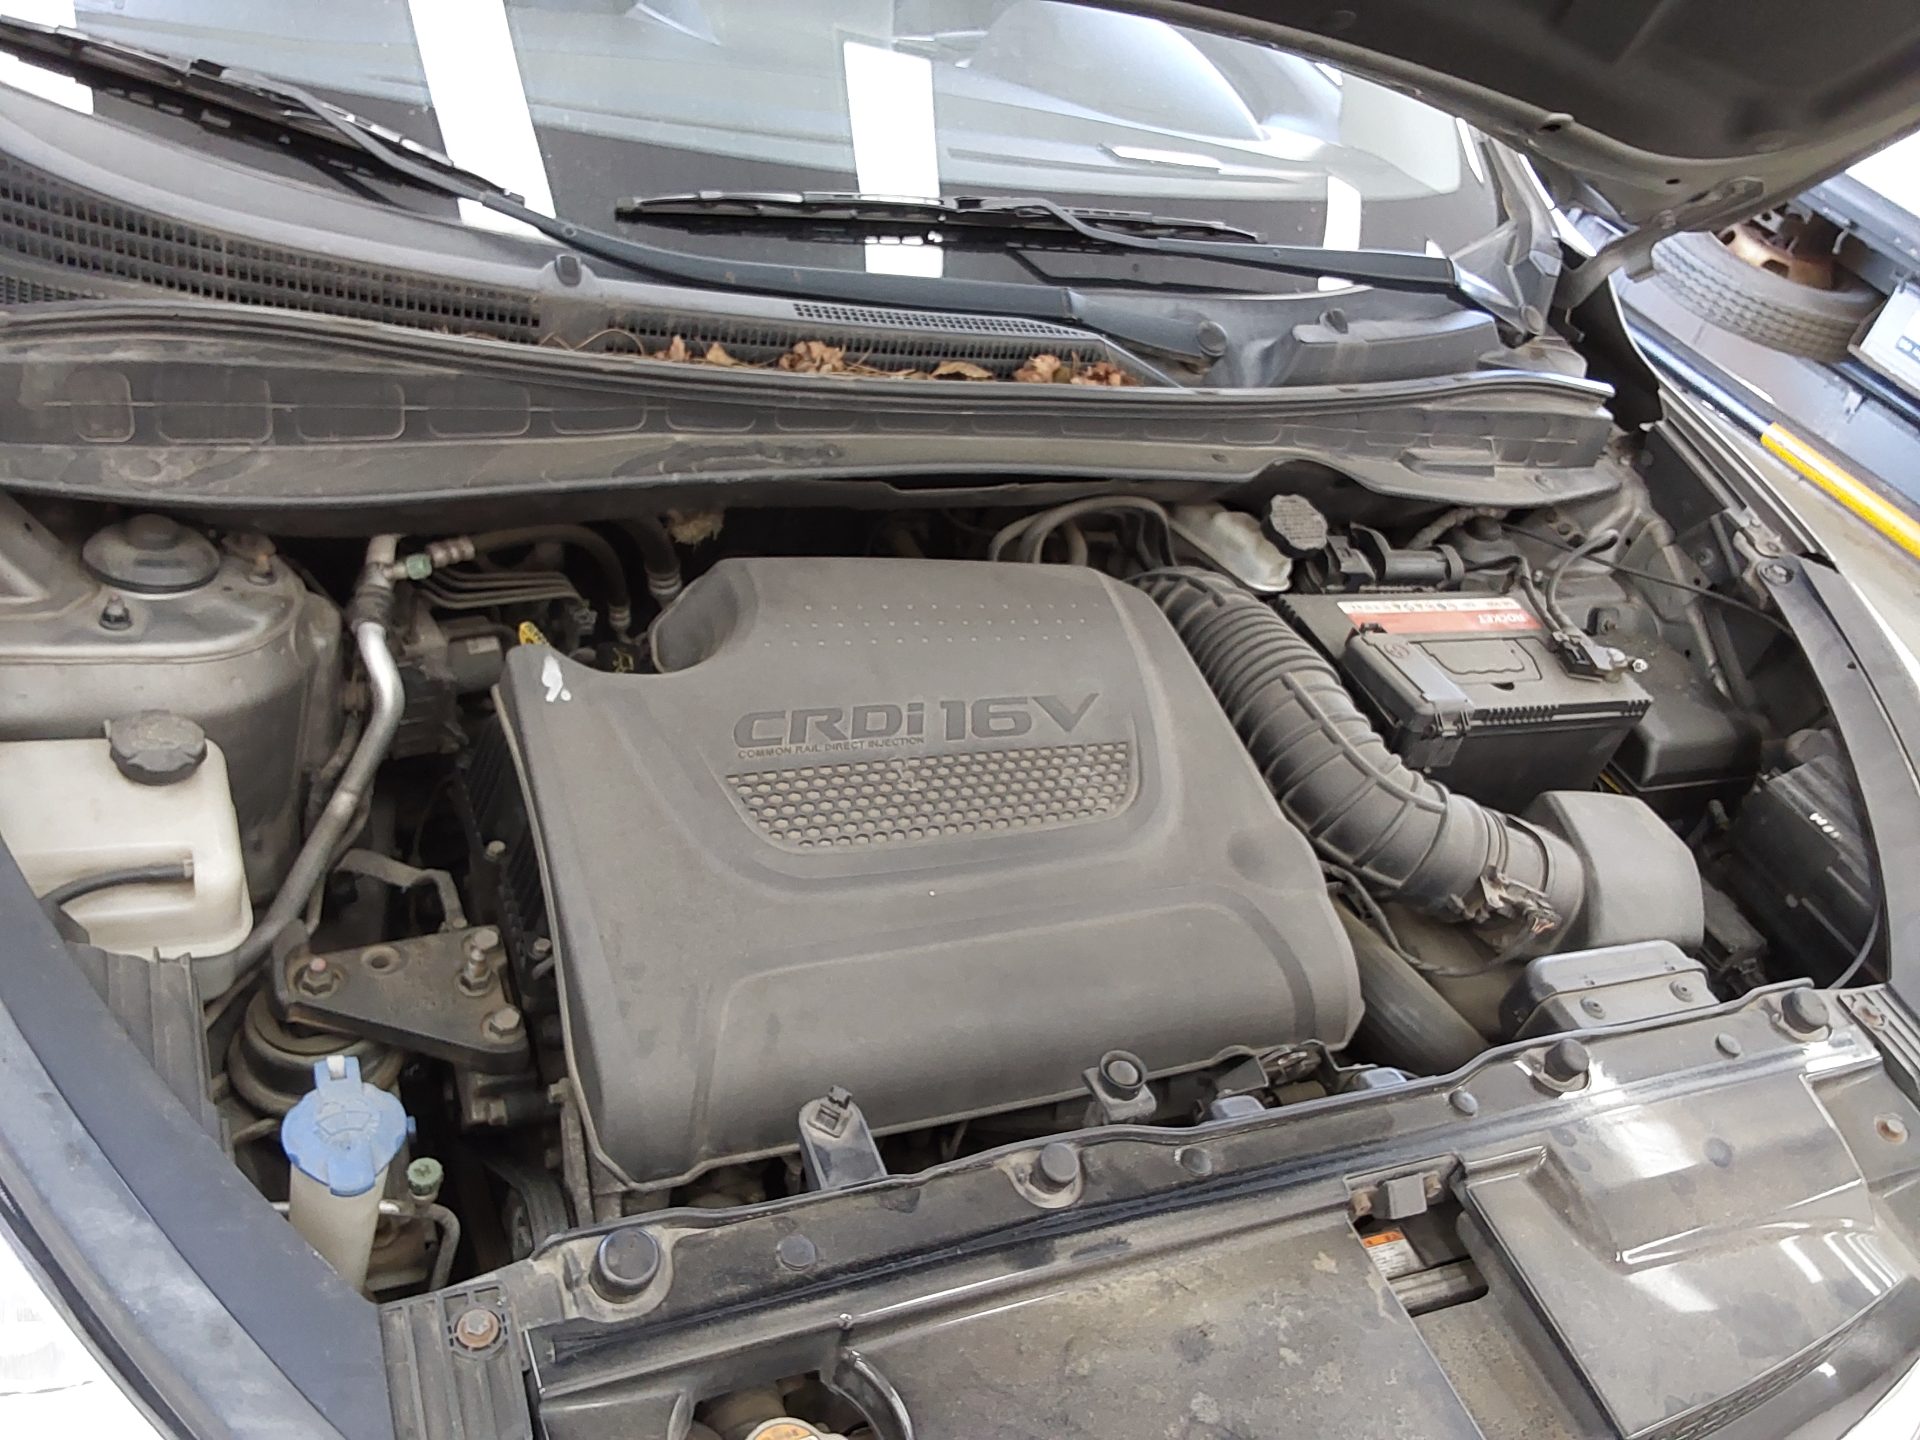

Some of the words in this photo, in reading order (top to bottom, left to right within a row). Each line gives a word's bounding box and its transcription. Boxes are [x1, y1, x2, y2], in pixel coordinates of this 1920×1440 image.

[1477, 613, 1526, 625] ROCKET
[733, 702, 924, 748] CRDi
[940, 692, 1099, 741] 16V
[738, 746, 792, 760] COMMON
[795, 744, 821, 754] RAIL
[824, 740, 865, 751] DIRECT
[868, 736, 925, 748] INJECTION
